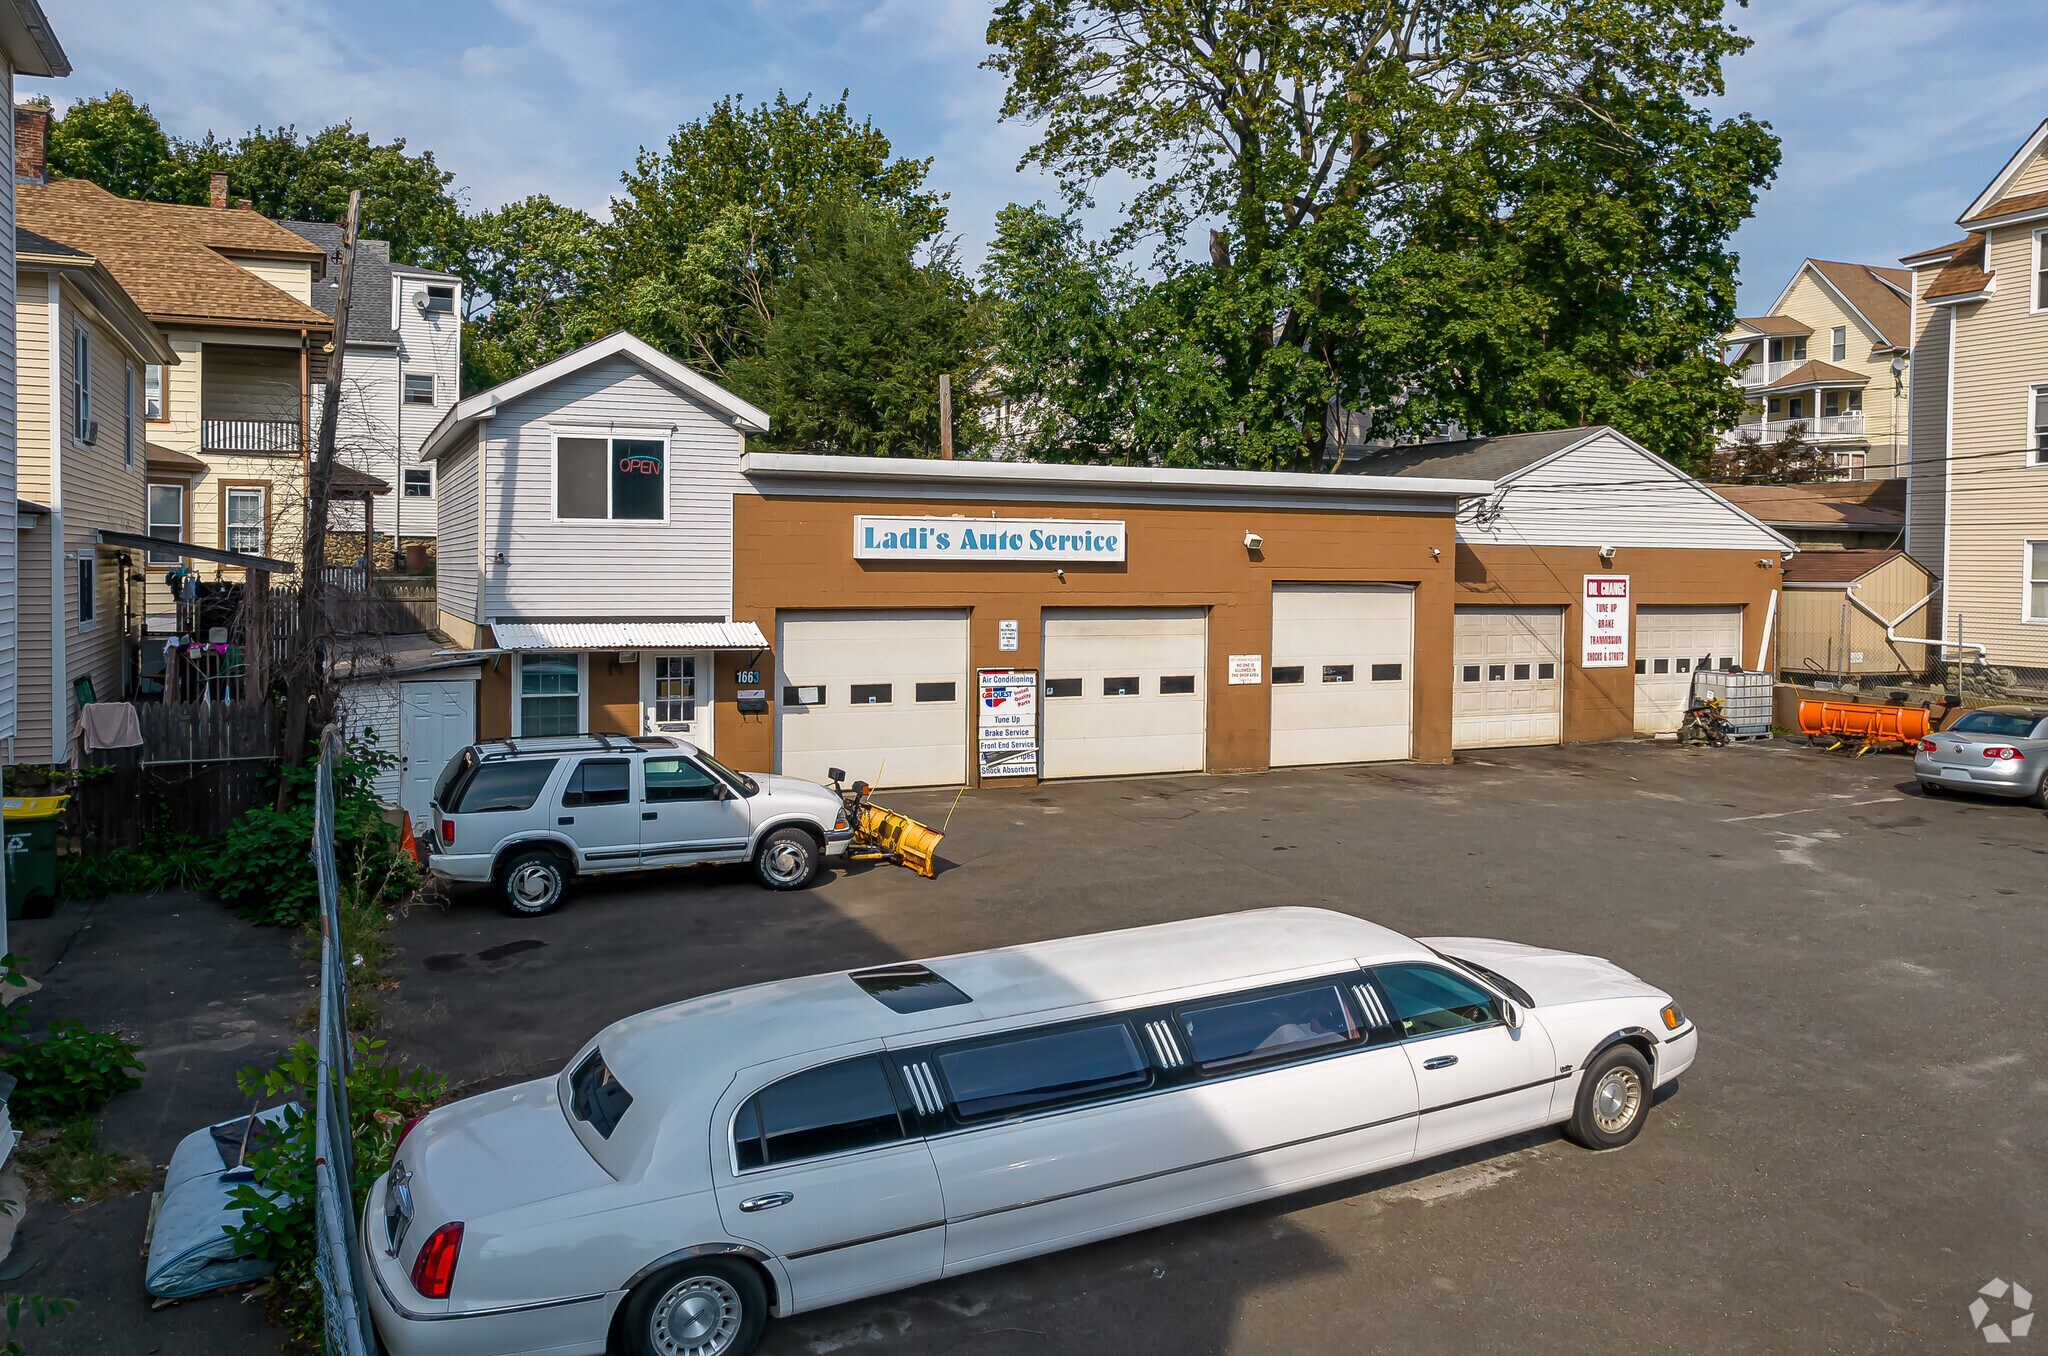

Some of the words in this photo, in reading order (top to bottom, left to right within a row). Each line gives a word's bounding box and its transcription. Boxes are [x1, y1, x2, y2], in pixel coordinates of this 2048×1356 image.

[620, 458, 660, 475] OPEN
[864, 527, 951, 550] Ladi's
[960, 528, 1023, 550] Auto
[1029, 529, 1119, 551] Service
[1588, 582, 1598, 595] OIL
[1600, 582, 1625, 595] CHANGE
[1596, 604, 1608, 613] TUNE
[1610, 604, 1617, 612] UP
[1598, 619, 1614, 628] BRAKE
[1587, 652, 1603, 661] SHOCKS
[736, 671, 759, 683] 1663
[994, 675, 1034, 684] Conditioning
[1014, 693, 1031, 701] Quality
[1011, 716, 1021, 725] Up
[985, 729, 1003, 737] Brake
[1005, 728, 1029, 736] Service
[998, 741, 1009, 749] End
[981, 766, 1001, 774] Shock
